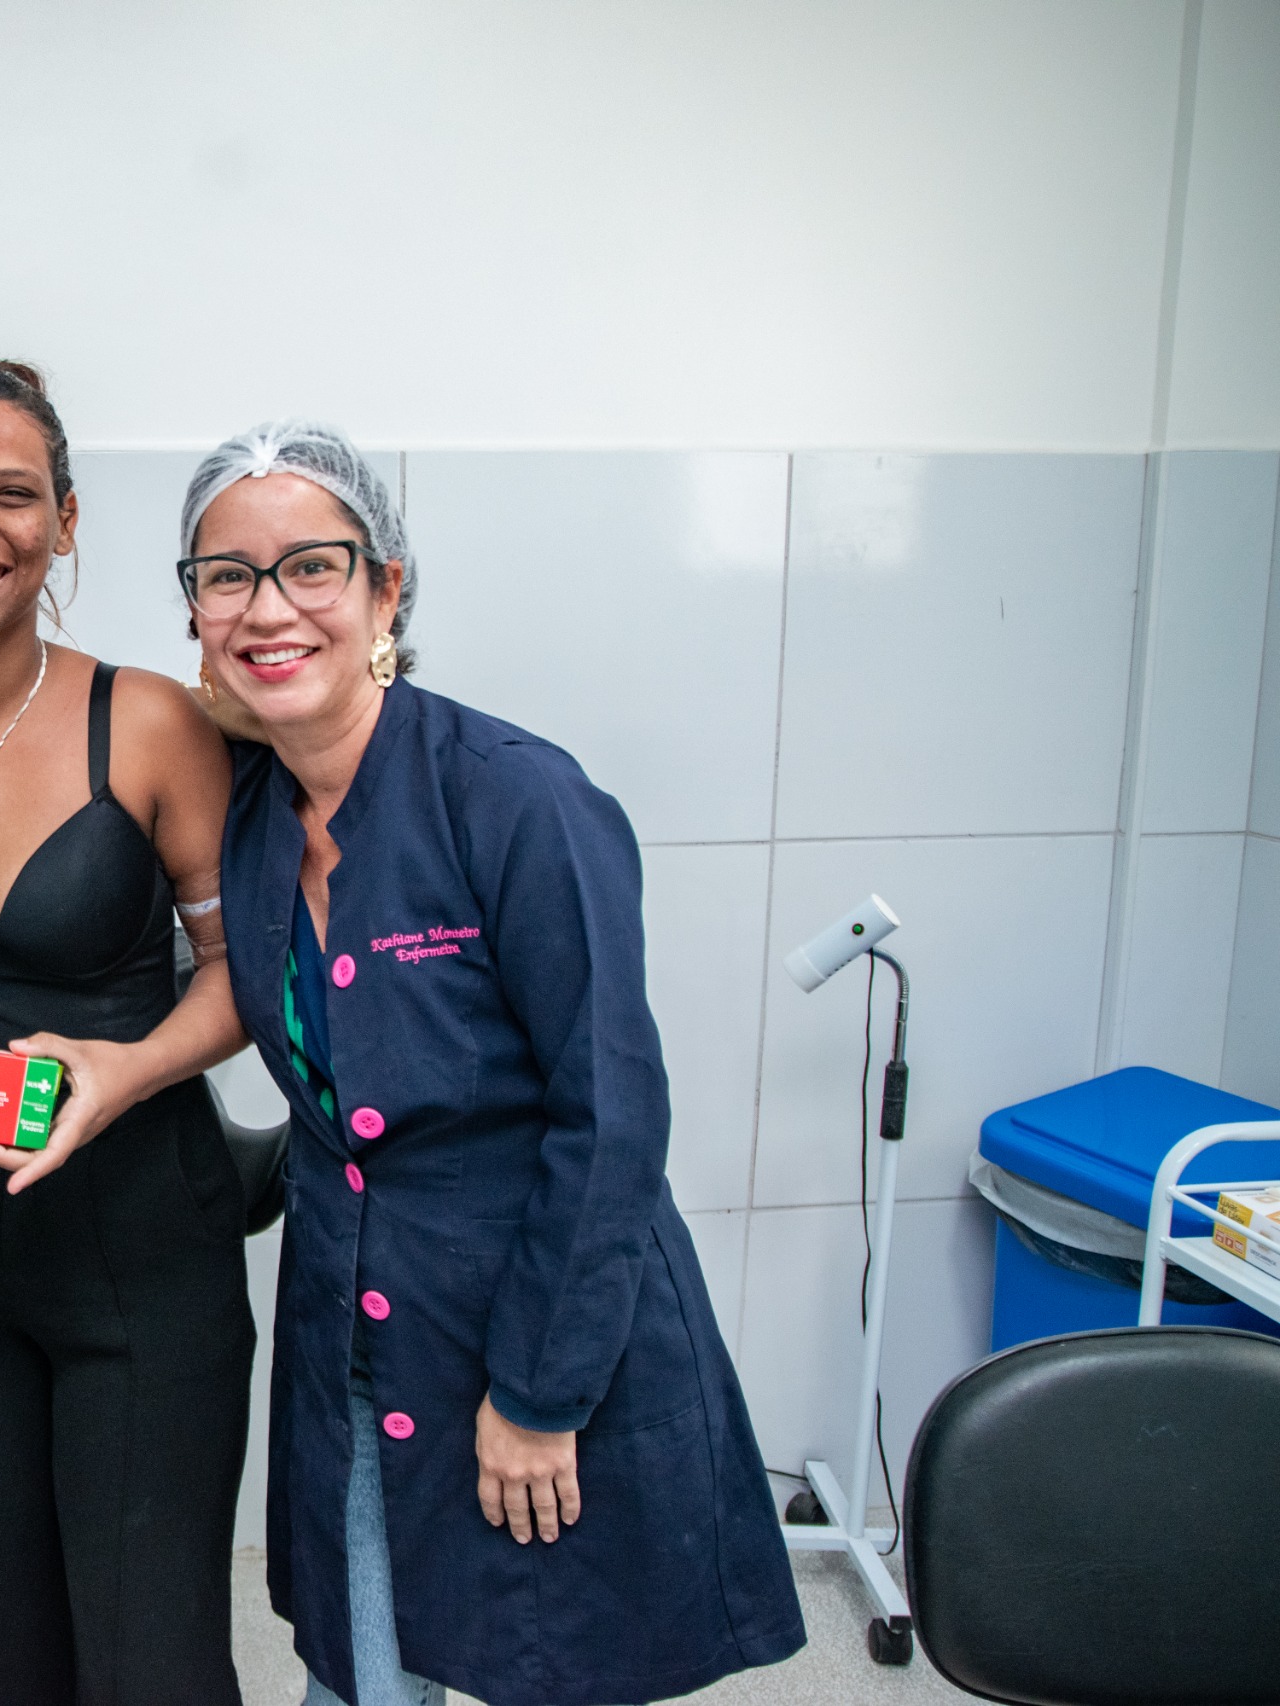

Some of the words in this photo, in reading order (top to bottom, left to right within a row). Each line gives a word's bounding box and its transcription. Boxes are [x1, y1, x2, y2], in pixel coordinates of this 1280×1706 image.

[371, 933, 425, 951] Kathiane
[428, 926, 479, 941] Monteiro
[396, 944, 460, 964] Enfermeira
[1220, 1196, 1238, 1211] Luvas
